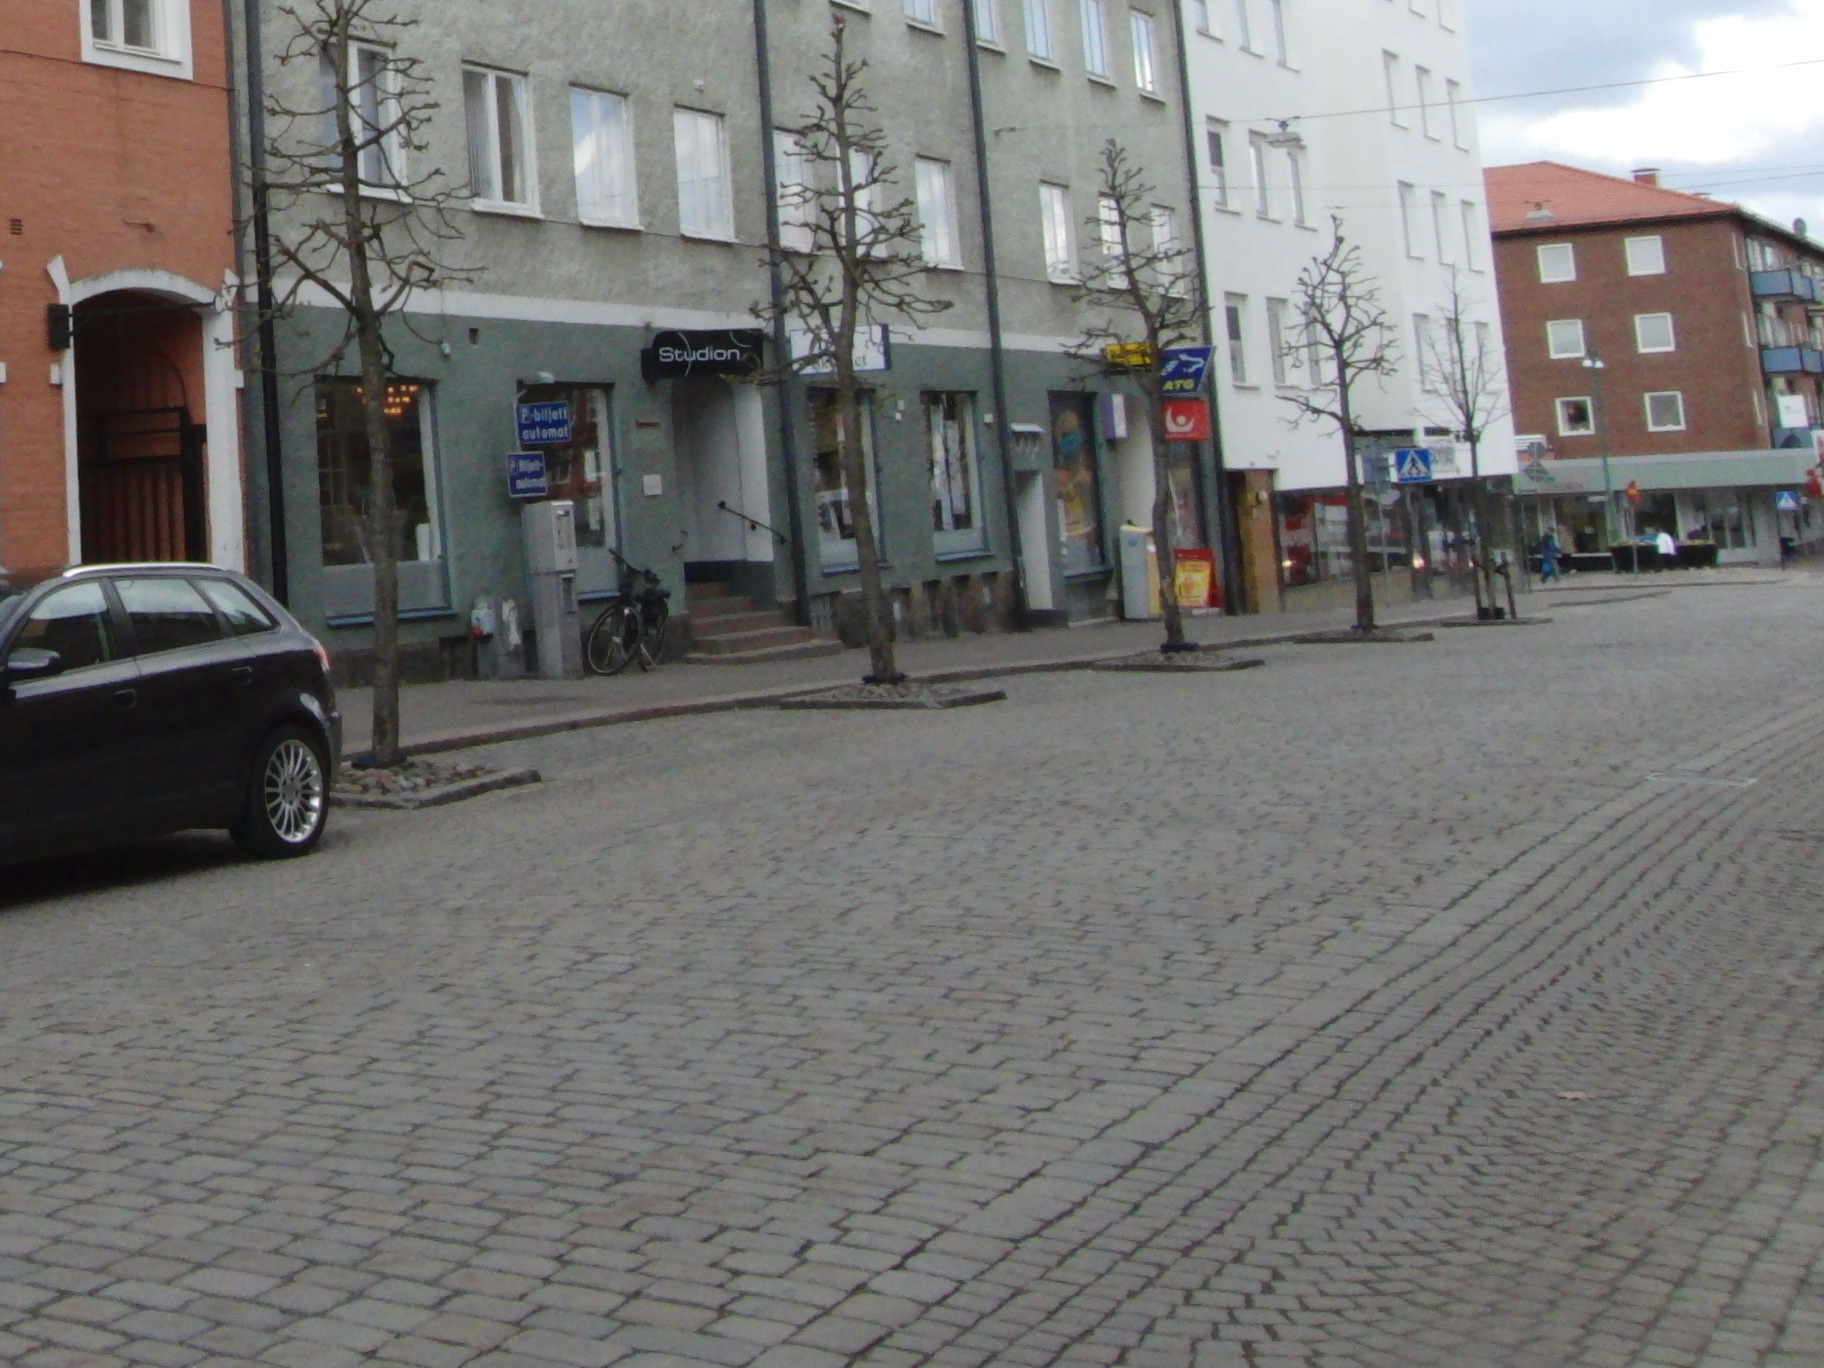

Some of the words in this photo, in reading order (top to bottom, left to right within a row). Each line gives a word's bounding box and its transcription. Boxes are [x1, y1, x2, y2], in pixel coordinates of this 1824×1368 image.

[659, 346, 741, 363] Studion
[1163, 379, 1194, 391] ATG
[521, 425, 568, 440] automat
